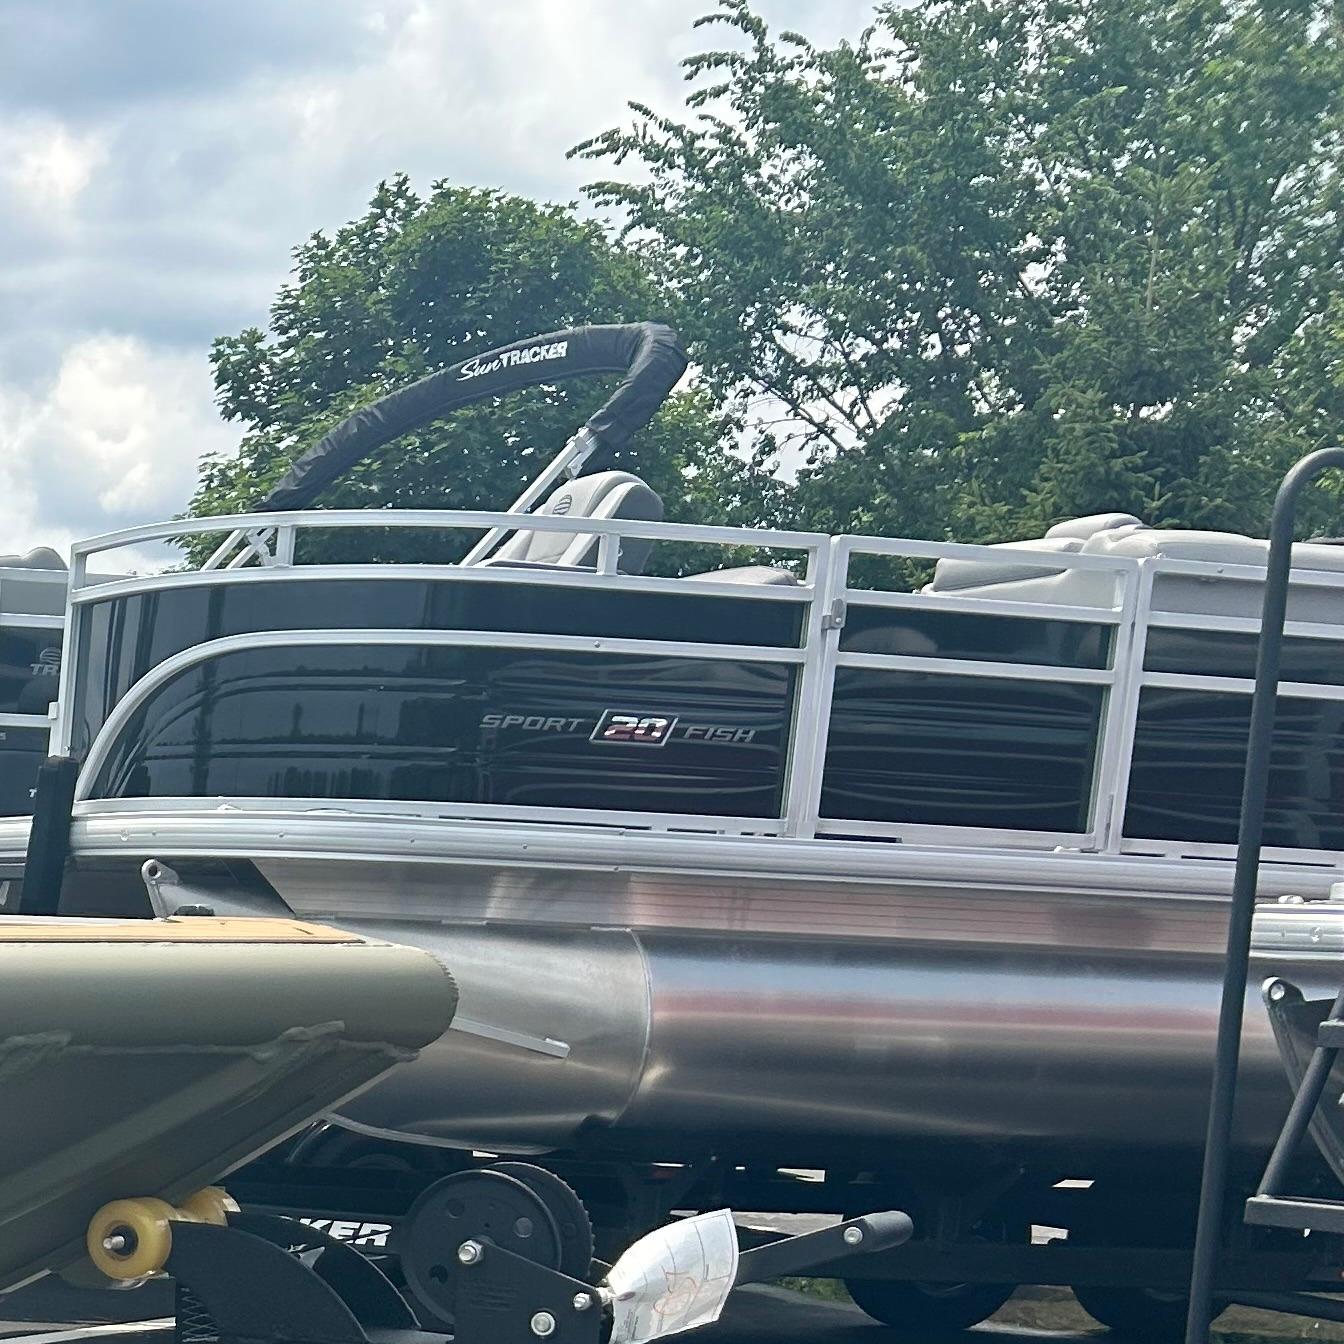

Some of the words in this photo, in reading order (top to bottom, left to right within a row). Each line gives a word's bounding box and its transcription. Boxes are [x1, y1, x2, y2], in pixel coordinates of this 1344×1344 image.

[479, 714, 584, 732] SPORT
[605, 715, 668, 742] 20
[683, 726, 757, 743] FISH
